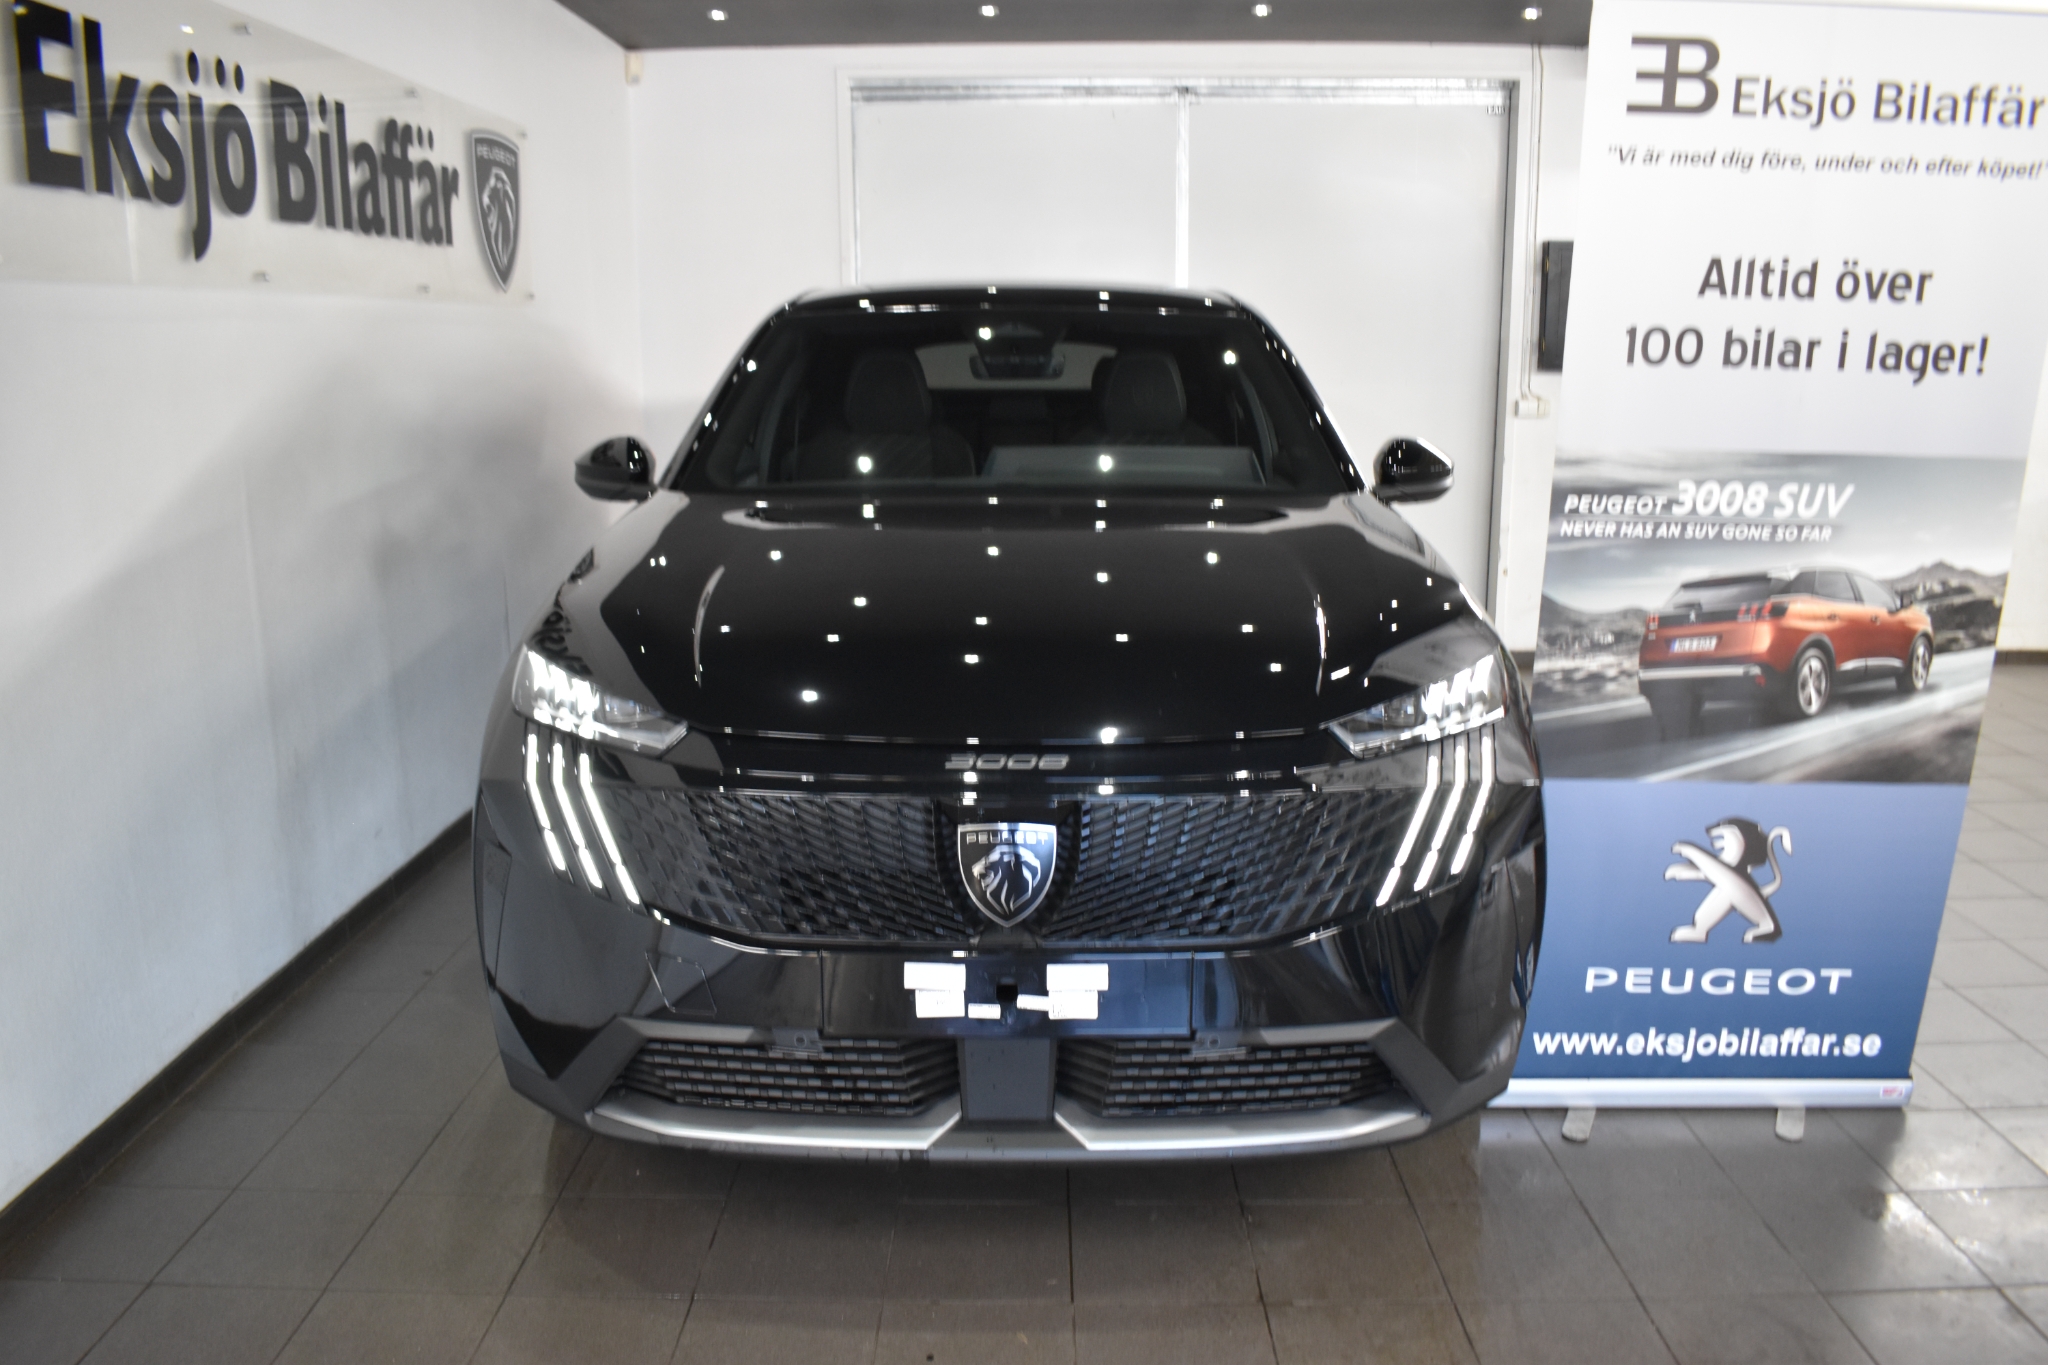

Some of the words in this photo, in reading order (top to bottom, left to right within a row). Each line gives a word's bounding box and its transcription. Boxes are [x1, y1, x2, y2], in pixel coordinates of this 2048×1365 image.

[1733, 76, 1856, 129] Eksjö
[1873, 80, 2046, 129] Bilaffär
[13, 0, 258, 262] Eksjö
[268, 78, 459, 248] Bilaffär
[1608, 144, 1637, 166] "Vi
[1643, 144, 1664, 167] är
[1670, 147, 1717, 168] med
[1722, 148, 1754, 174] dig
[1761, 148, 1806, 174] före,
[1815, 152, 1875, 174] under
[1881, 153, 1919, 175] och
[1925, 155, 1972, 177] efter
[1698, 256, 1819, 300] Alltid
[1836, 259, 1933, 304] över
[1626, 325, 1704, 367] 100
[1722, 328, 1821, 370] bilar
[1838, 330, 1849, 370] i
[1865, 332, 1989, 386] lager!
[1564, 493, 1668, 516] PEUGEOT
[1671, 479, 1769, 518] 3008
[1773, 482, 1855, 520] SUV
[1560, 519, 1616, 538] NEVER
[1620, 520, 1653, 539] HAS
[1656, 522, 1681, 540] AN
[1684, 522, 1719, 540] SUV
[1722, 523, 1772, 541] GONE
[1775, 524, 1798, 542] SO
[1801, 525, 1833, 542] FAR
[945, 753, 1069, 770] 3008
[966, 831, 1049, 845] PEUGEOT
[1585, 966, 1853, 996] PEUGEOT
[1533, 1027, 1882, 1062] www.eksjobilaffar.se
